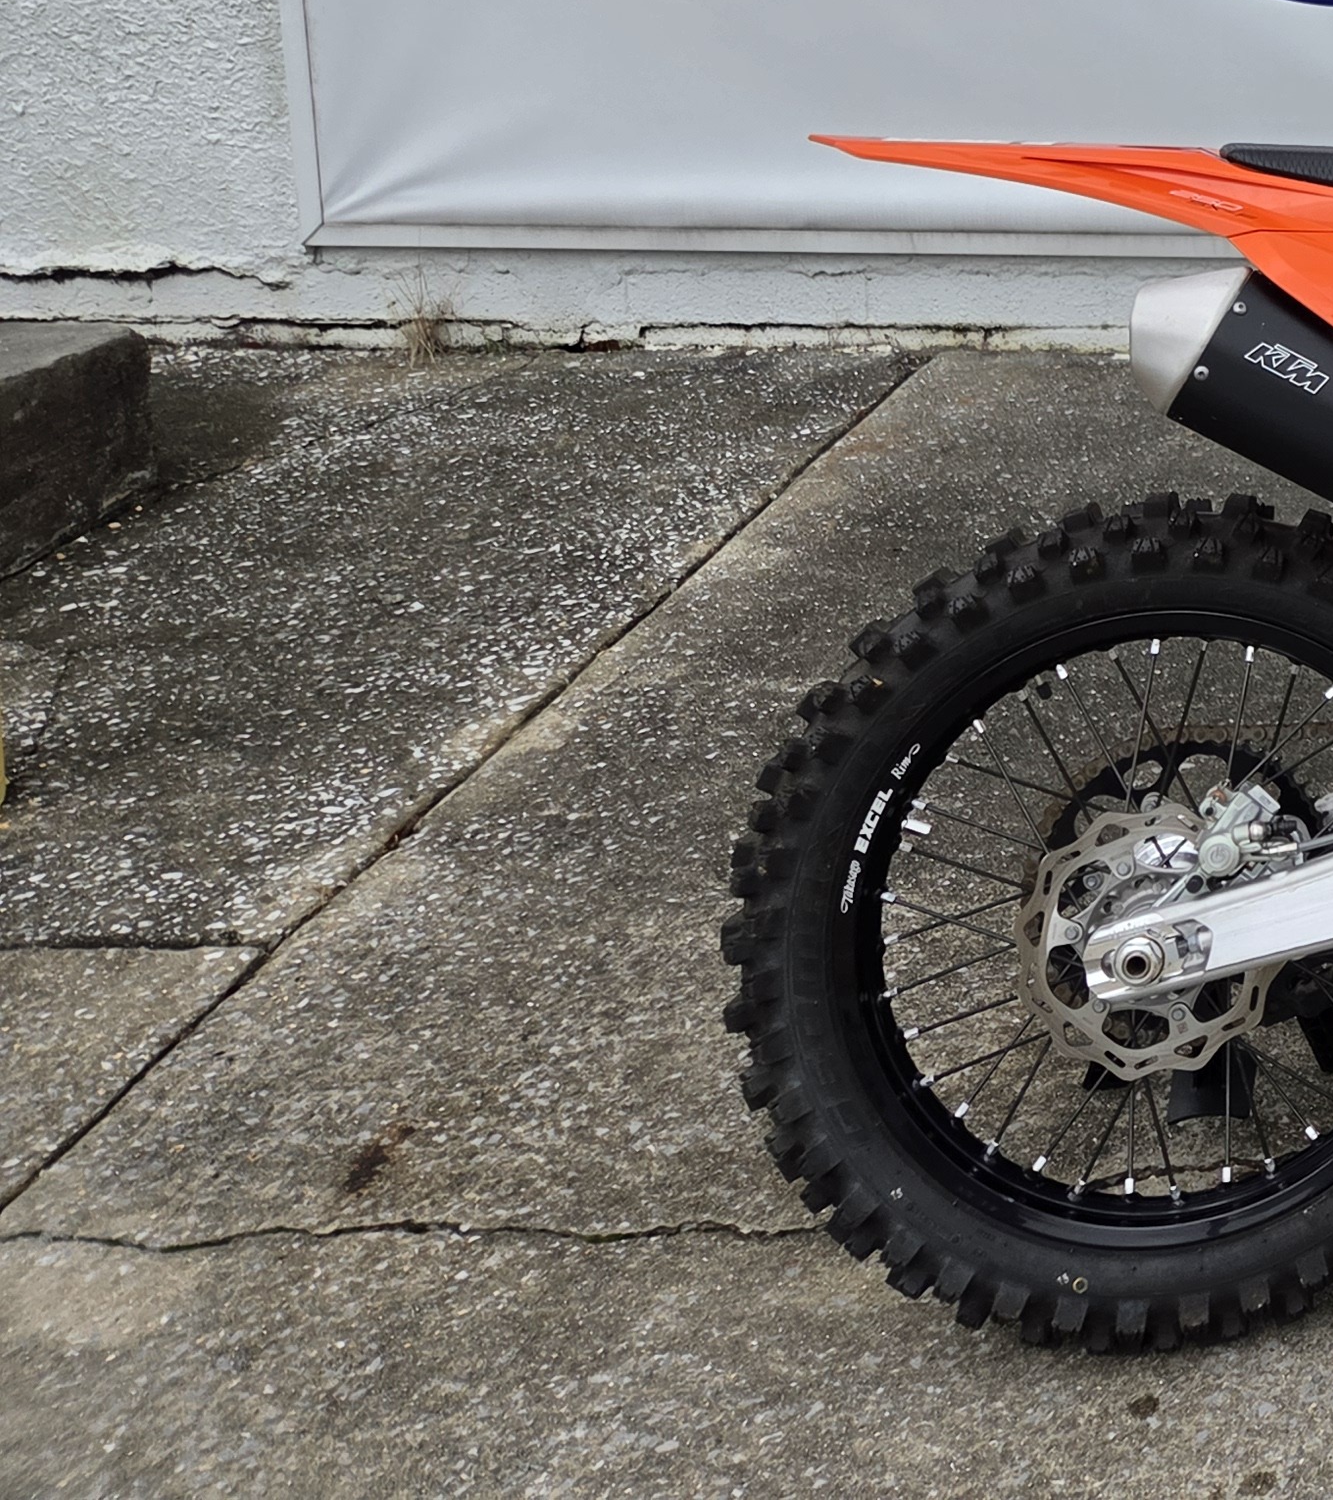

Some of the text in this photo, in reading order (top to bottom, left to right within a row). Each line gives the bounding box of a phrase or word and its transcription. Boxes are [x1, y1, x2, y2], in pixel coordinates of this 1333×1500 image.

[1244, 342, 1330, 395] KTM
[854, 788, 894, 854] EXCEL
[890, 743, 921, 780] Rim
